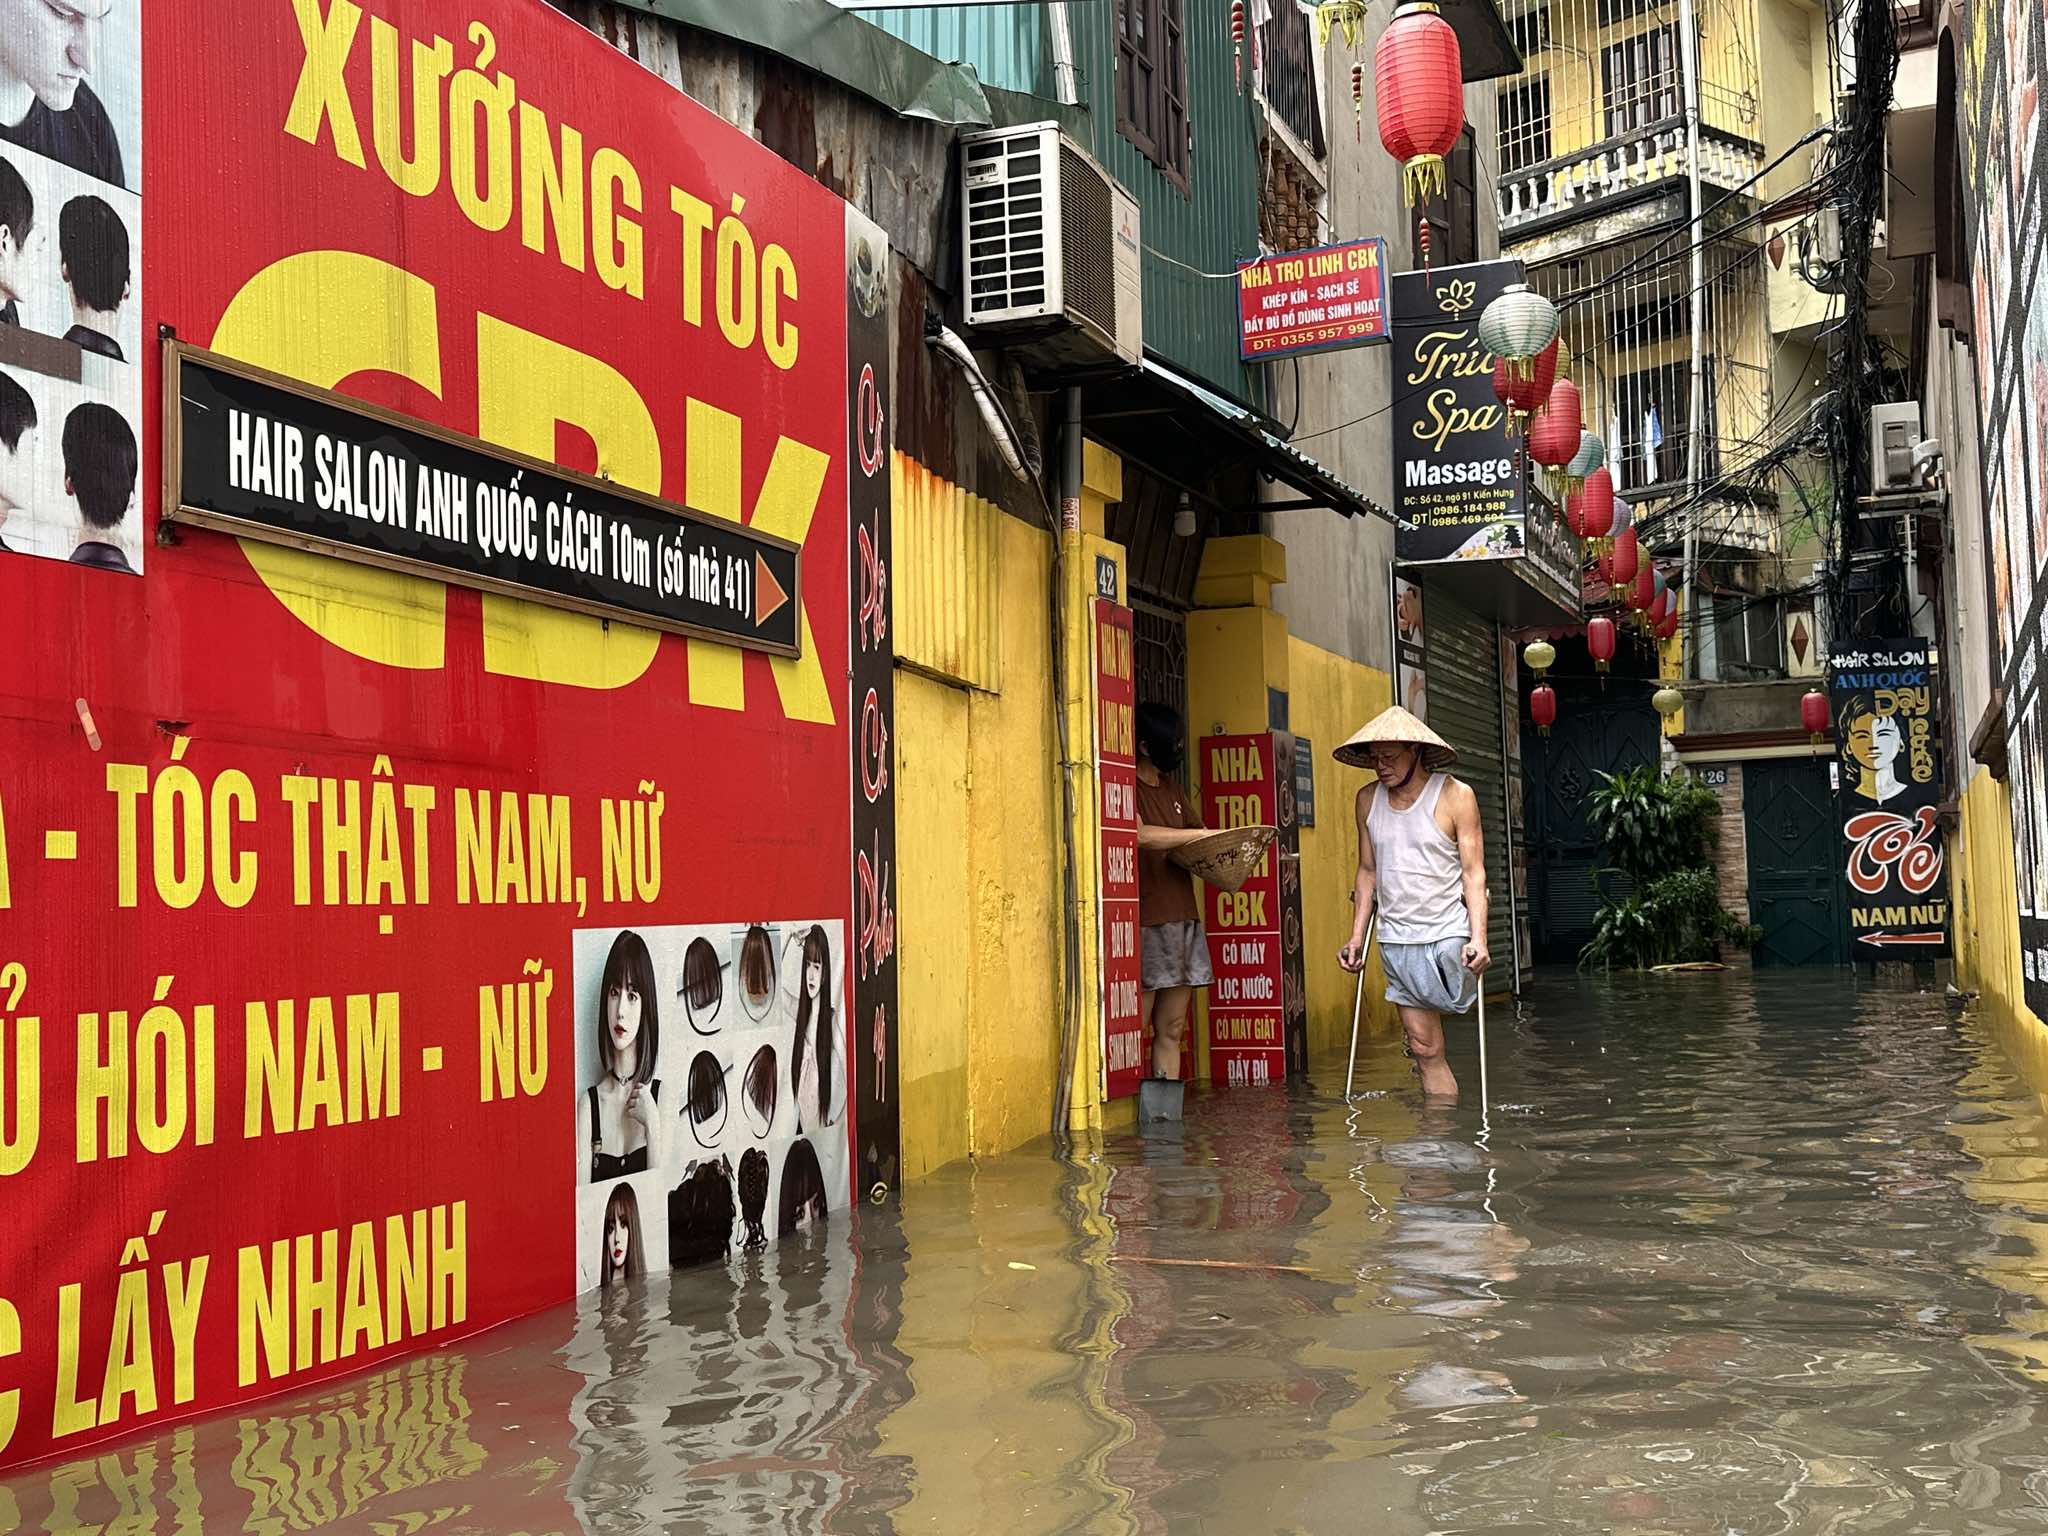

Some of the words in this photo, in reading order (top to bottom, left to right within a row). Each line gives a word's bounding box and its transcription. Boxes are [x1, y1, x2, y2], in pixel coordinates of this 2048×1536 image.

[283, 0, 644, 301] XƯỞNG
[670, 185, 799, 370] TÓC
[1241, 262, 1272, 289] NHÀ
[1275, 260, 1304, 284] TRỌ
[1308, 253, 1343, 278] LINH
[1347, 247, 1379, 271] CBK
[1262, 291, 1288, 310] KHÉP
[1290, 288, 1308, 305] KÍN
[1316, 284, 1344, 302] SẠCH
[1297, 307, 1326, 325] DÙNG
[1327, 303, 1352, 321] SINH
[1353, 298, 1380, 316] HOẠT
[1253, 339, 1276, 350] ĐT:
[1280, 331, 1314, 346] 0355
[1318, 327, 1343, 340] 957
[1348, 321, 1374, 335] 999
[1412, 388, 1503, 452] Spa
[1404, 457, 1512, 488] Massage
[229, 409, 304, 503] HAIR
[315, 433, 406, 528] SALON
[415, 465, 469, 544] ANH
[475, 470, 538, 561] QUỐC
[545, 491, 603, 576] CÁCH
[609, 521, 651, 588] 10m
[656, 524, 685, 599] (số
[688, 546, 721, 606] nhà
[723, 558, 751, 620] 41)
[1404, 497, 1418, 506] ĐC:
[1420, 494, 1431, 504] Số
[1462, 492, 1471, 500] 91
[1433, 501, 1506, 515] 0986.184.988
[1099, 562, 1115, 596] 42
[1835, 673, 1875, 689] ANH
[1211, 739, 1264, 783] NHÀ
[1707, 770, 1725, 783] 26
[106, 736, 258, 909] TÓC
[281, 755, 438, 935] THẬT
[455, 789, 587, 918] NAM,
[601, 779, 664, 904] NỮ
[1217, 890, 1268, 927] CBK
[1851, 906, 1907, 928] NAM
[1910, 899, 1947, 925] NỮ
[1222, 938, 1237, 965] CÓ
[1240, 938, 1266, 964] MÁY
[1218, 977, 1239, 1004] LỌC
[1242, 973, 1273, 999] NƯỚC
[1216, 1013, 1229, 1040] CÓ
[1231, 1013, 1252, 1040] MÁY
[1254, 1014, 1276, 1045] GIẶT
[75, 974, 215, 1165] HÓI
[243, 991, 400, 1139] NAM
[479, 957, 554, 1102] NỮ
[52, 1210, 210, 1439] LẤY
[237, 1200, 466, 1387] NHANH
